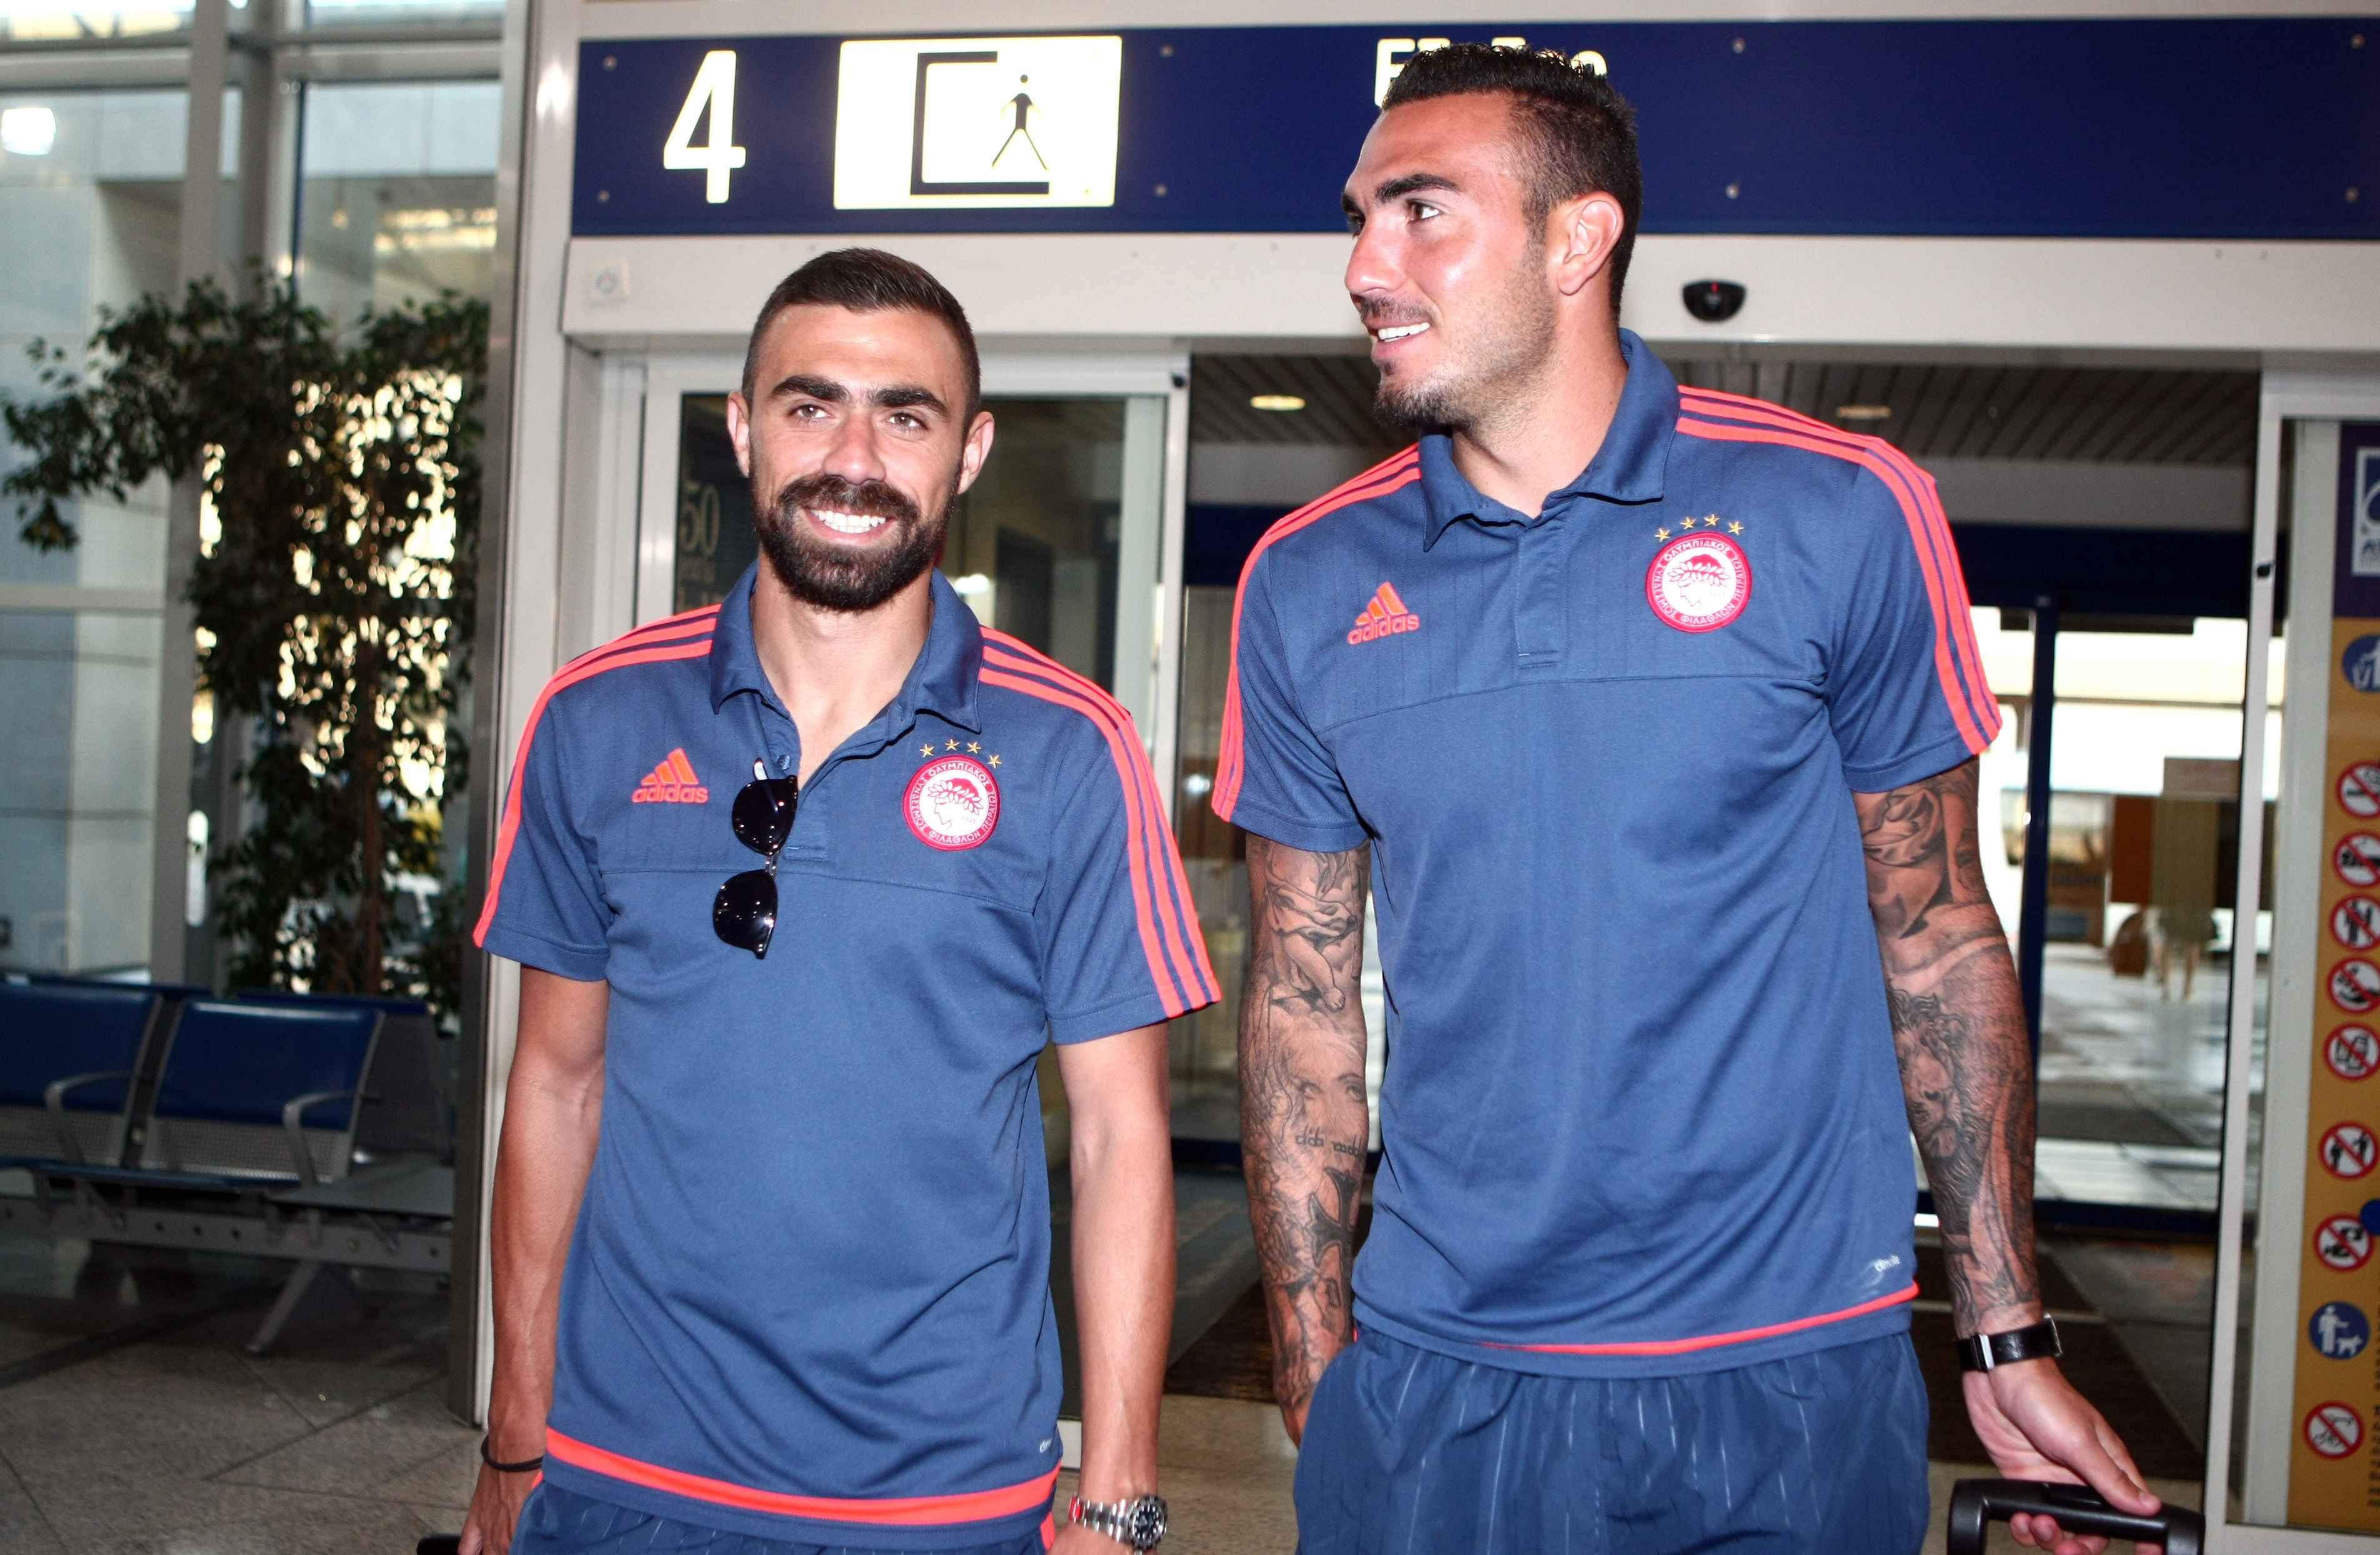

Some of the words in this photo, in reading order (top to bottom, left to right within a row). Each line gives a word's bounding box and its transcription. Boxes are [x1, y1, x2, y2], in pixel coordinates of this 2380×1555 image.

[663, 50, 746, 203] 4
[1664, 540, 1730, 561] ΟΛΥΜΠΙΑΚΟΣ
[1681, 604, 1735, 624] ΦΙΛΑΘΛΩΝ
[1347, 614, 1421, 646] adidas
[928, 762, 991, 787] ΟΛΥΜΠΙΑΚΟΣ
[631, 783, 709, 804] adidas
[912, 777, 928, 831] ΣΥΝΔΕΣΜΟΣ
[982, 791, 996, 832] ΠΕΙΡΑΙΩΣ
[929, 830, 981, 844] ΦΙΛΑΘΛΩΝ
